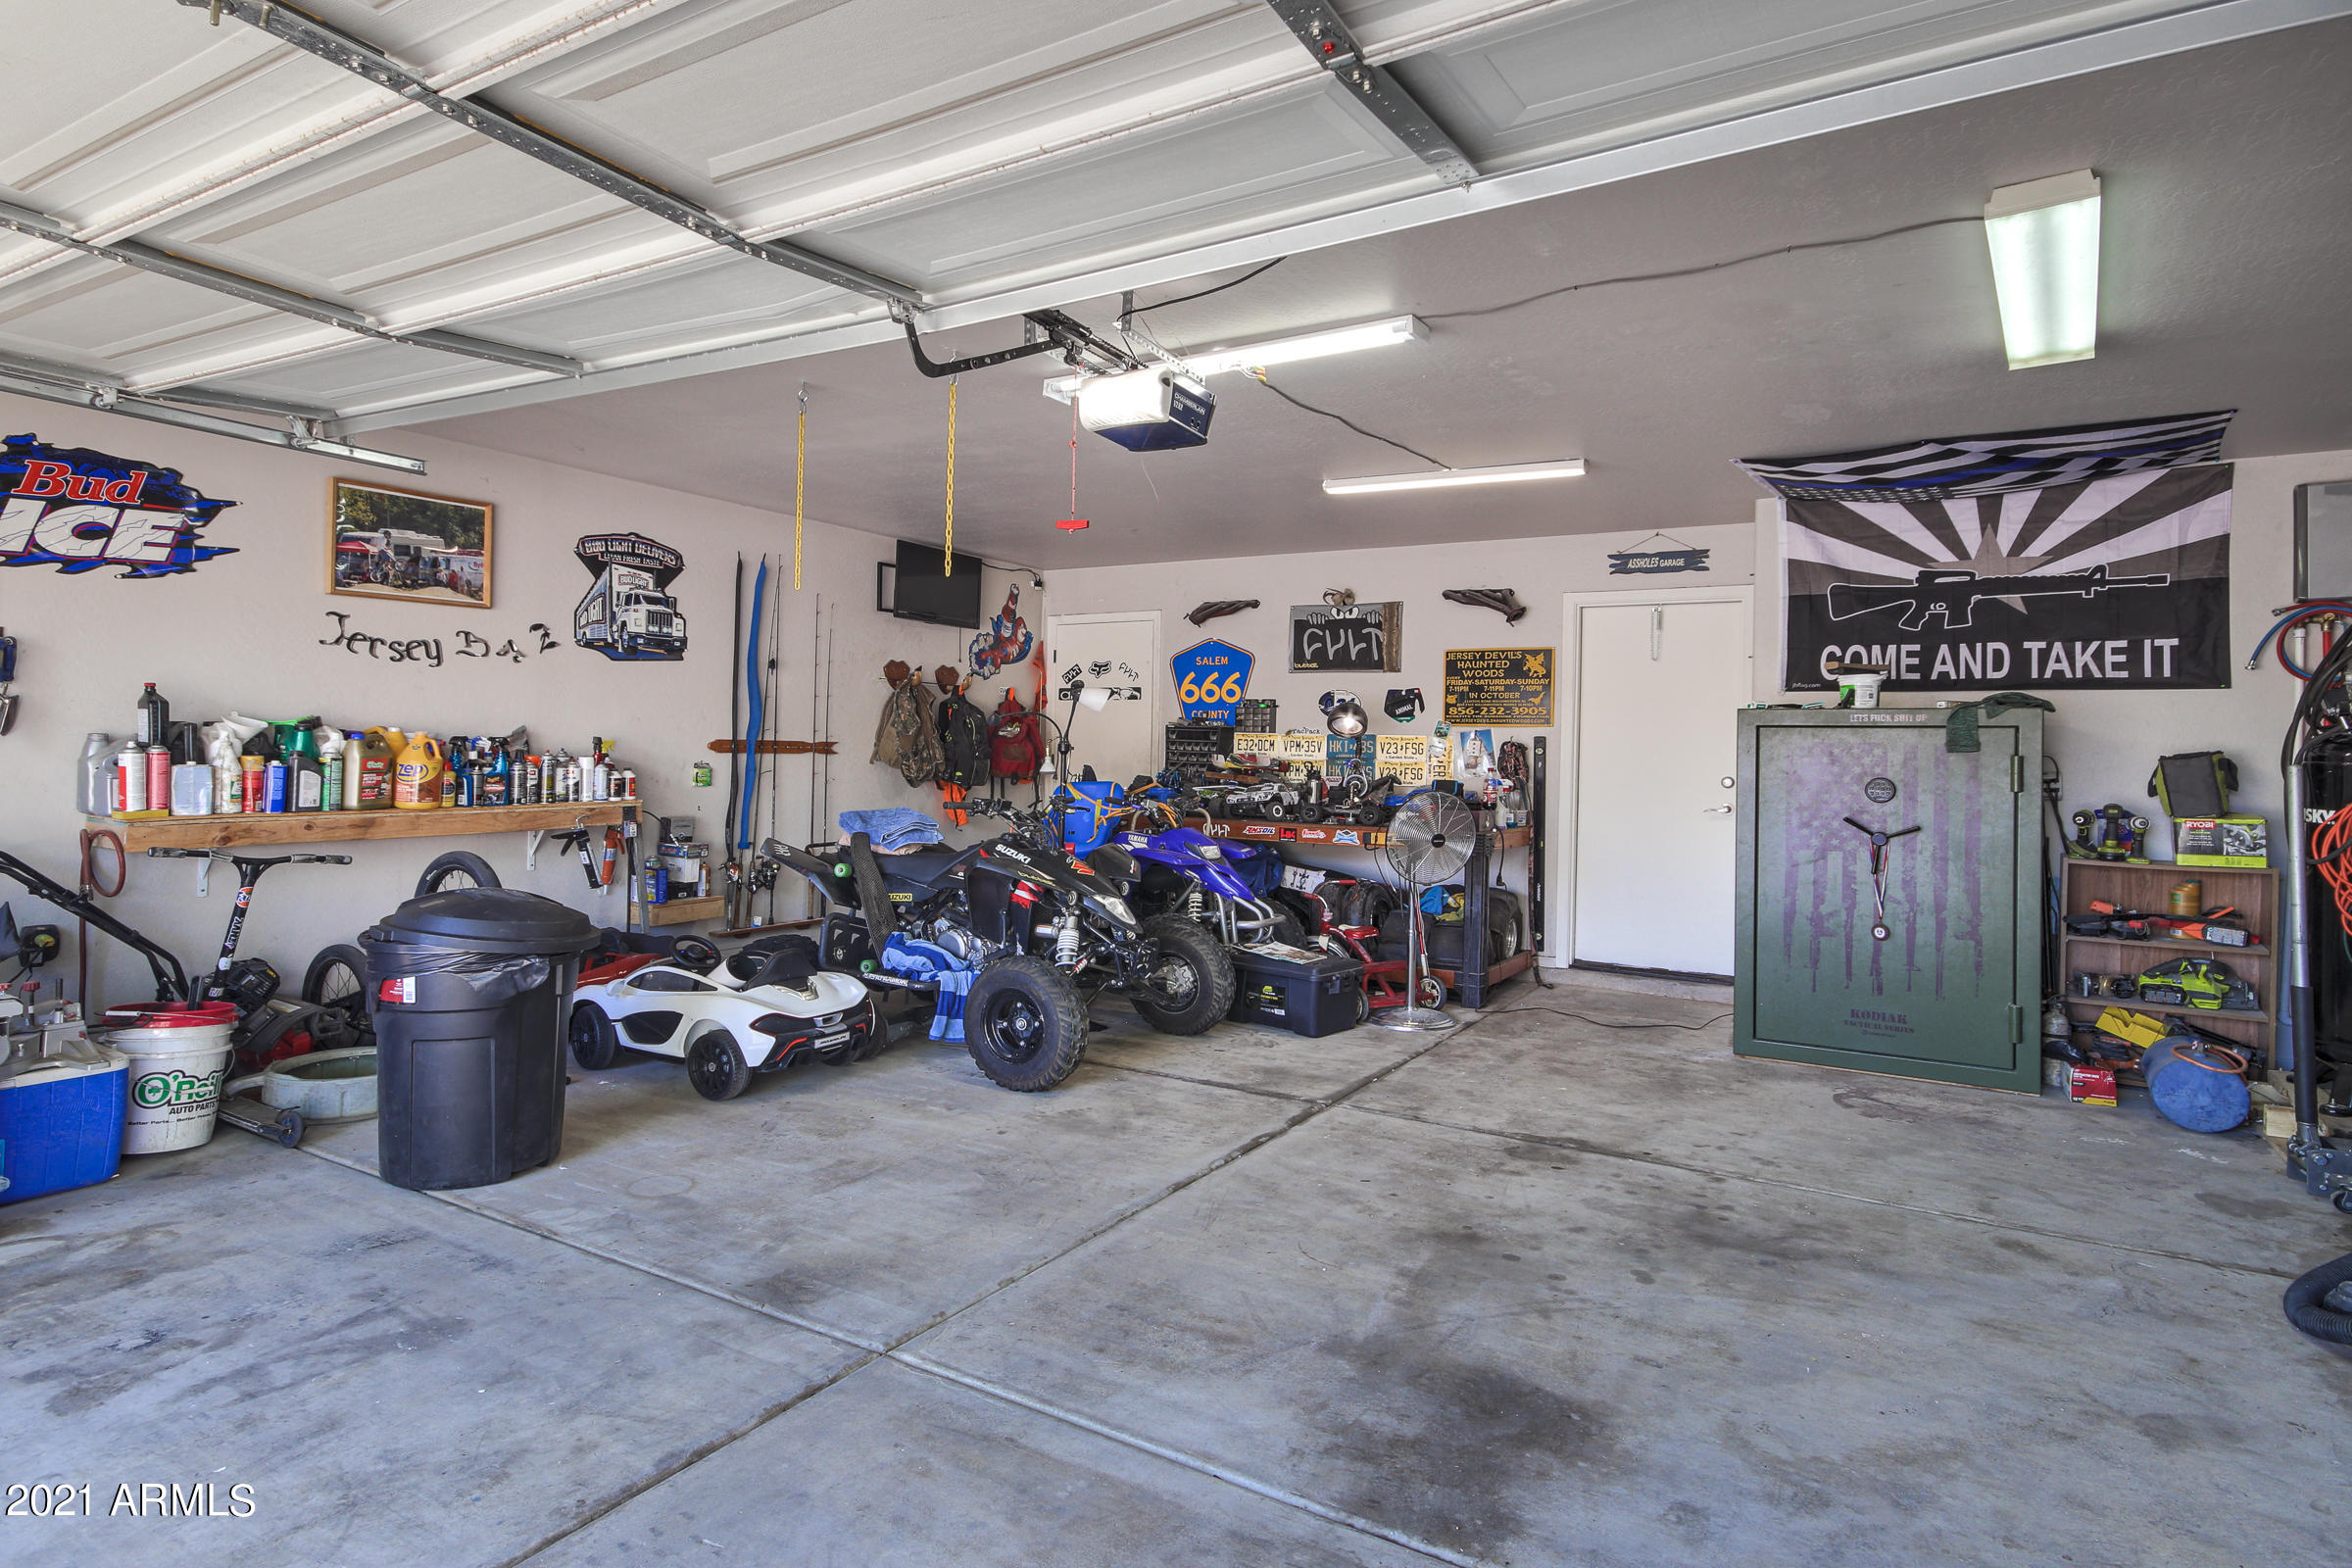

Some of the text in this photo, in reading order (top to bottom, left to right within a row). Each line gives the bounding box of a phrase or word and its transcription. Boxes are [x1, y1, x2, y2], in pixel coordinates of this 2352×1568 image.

[11, 459, 148, 504] Bud
[0, 498, 186, 563] ICE
[584, 540, 606, 553] BUD
[608, 539, 632, 554] LIGHT
[1627, 557, 1685, 568] ASSHOLES GARAGE
[318, 611, 444, 667] Jersey
[1196, 657, 1229, 665] SALEM
[1446, 651, 1522, 661] JERSEY DEVIL'S
[1820, 638, 2180, 681] COME AND TAKE IT
[1462, 669, 1504, 678] WOODS
[1180, 671, 1242, 704] 666
[1395, 705, 1413, 715] ANIMAL
[1448, 707, 1547, 715] 856-232-3905
[1849, 713, 1869, 722] LETS
[1915, 713, 1928, 722] UP
[1237, 739, 1254, 752] E32
[1284, 740, 1323, 753] VPM 35V
[1380, 742, 1424, 755] V23 FSG
[1403, 767, 1423, 780] FSG
[1245, 825, 1275, 834] AMSOIL
[1128, 834, 1149, 844] YAMAHA
[995, 844, 1031, 864] SUZUKI
[1850, 1008, 1908, 1025] KODIAK
[169, 1102, 216, 1115] AUTO PARTS
